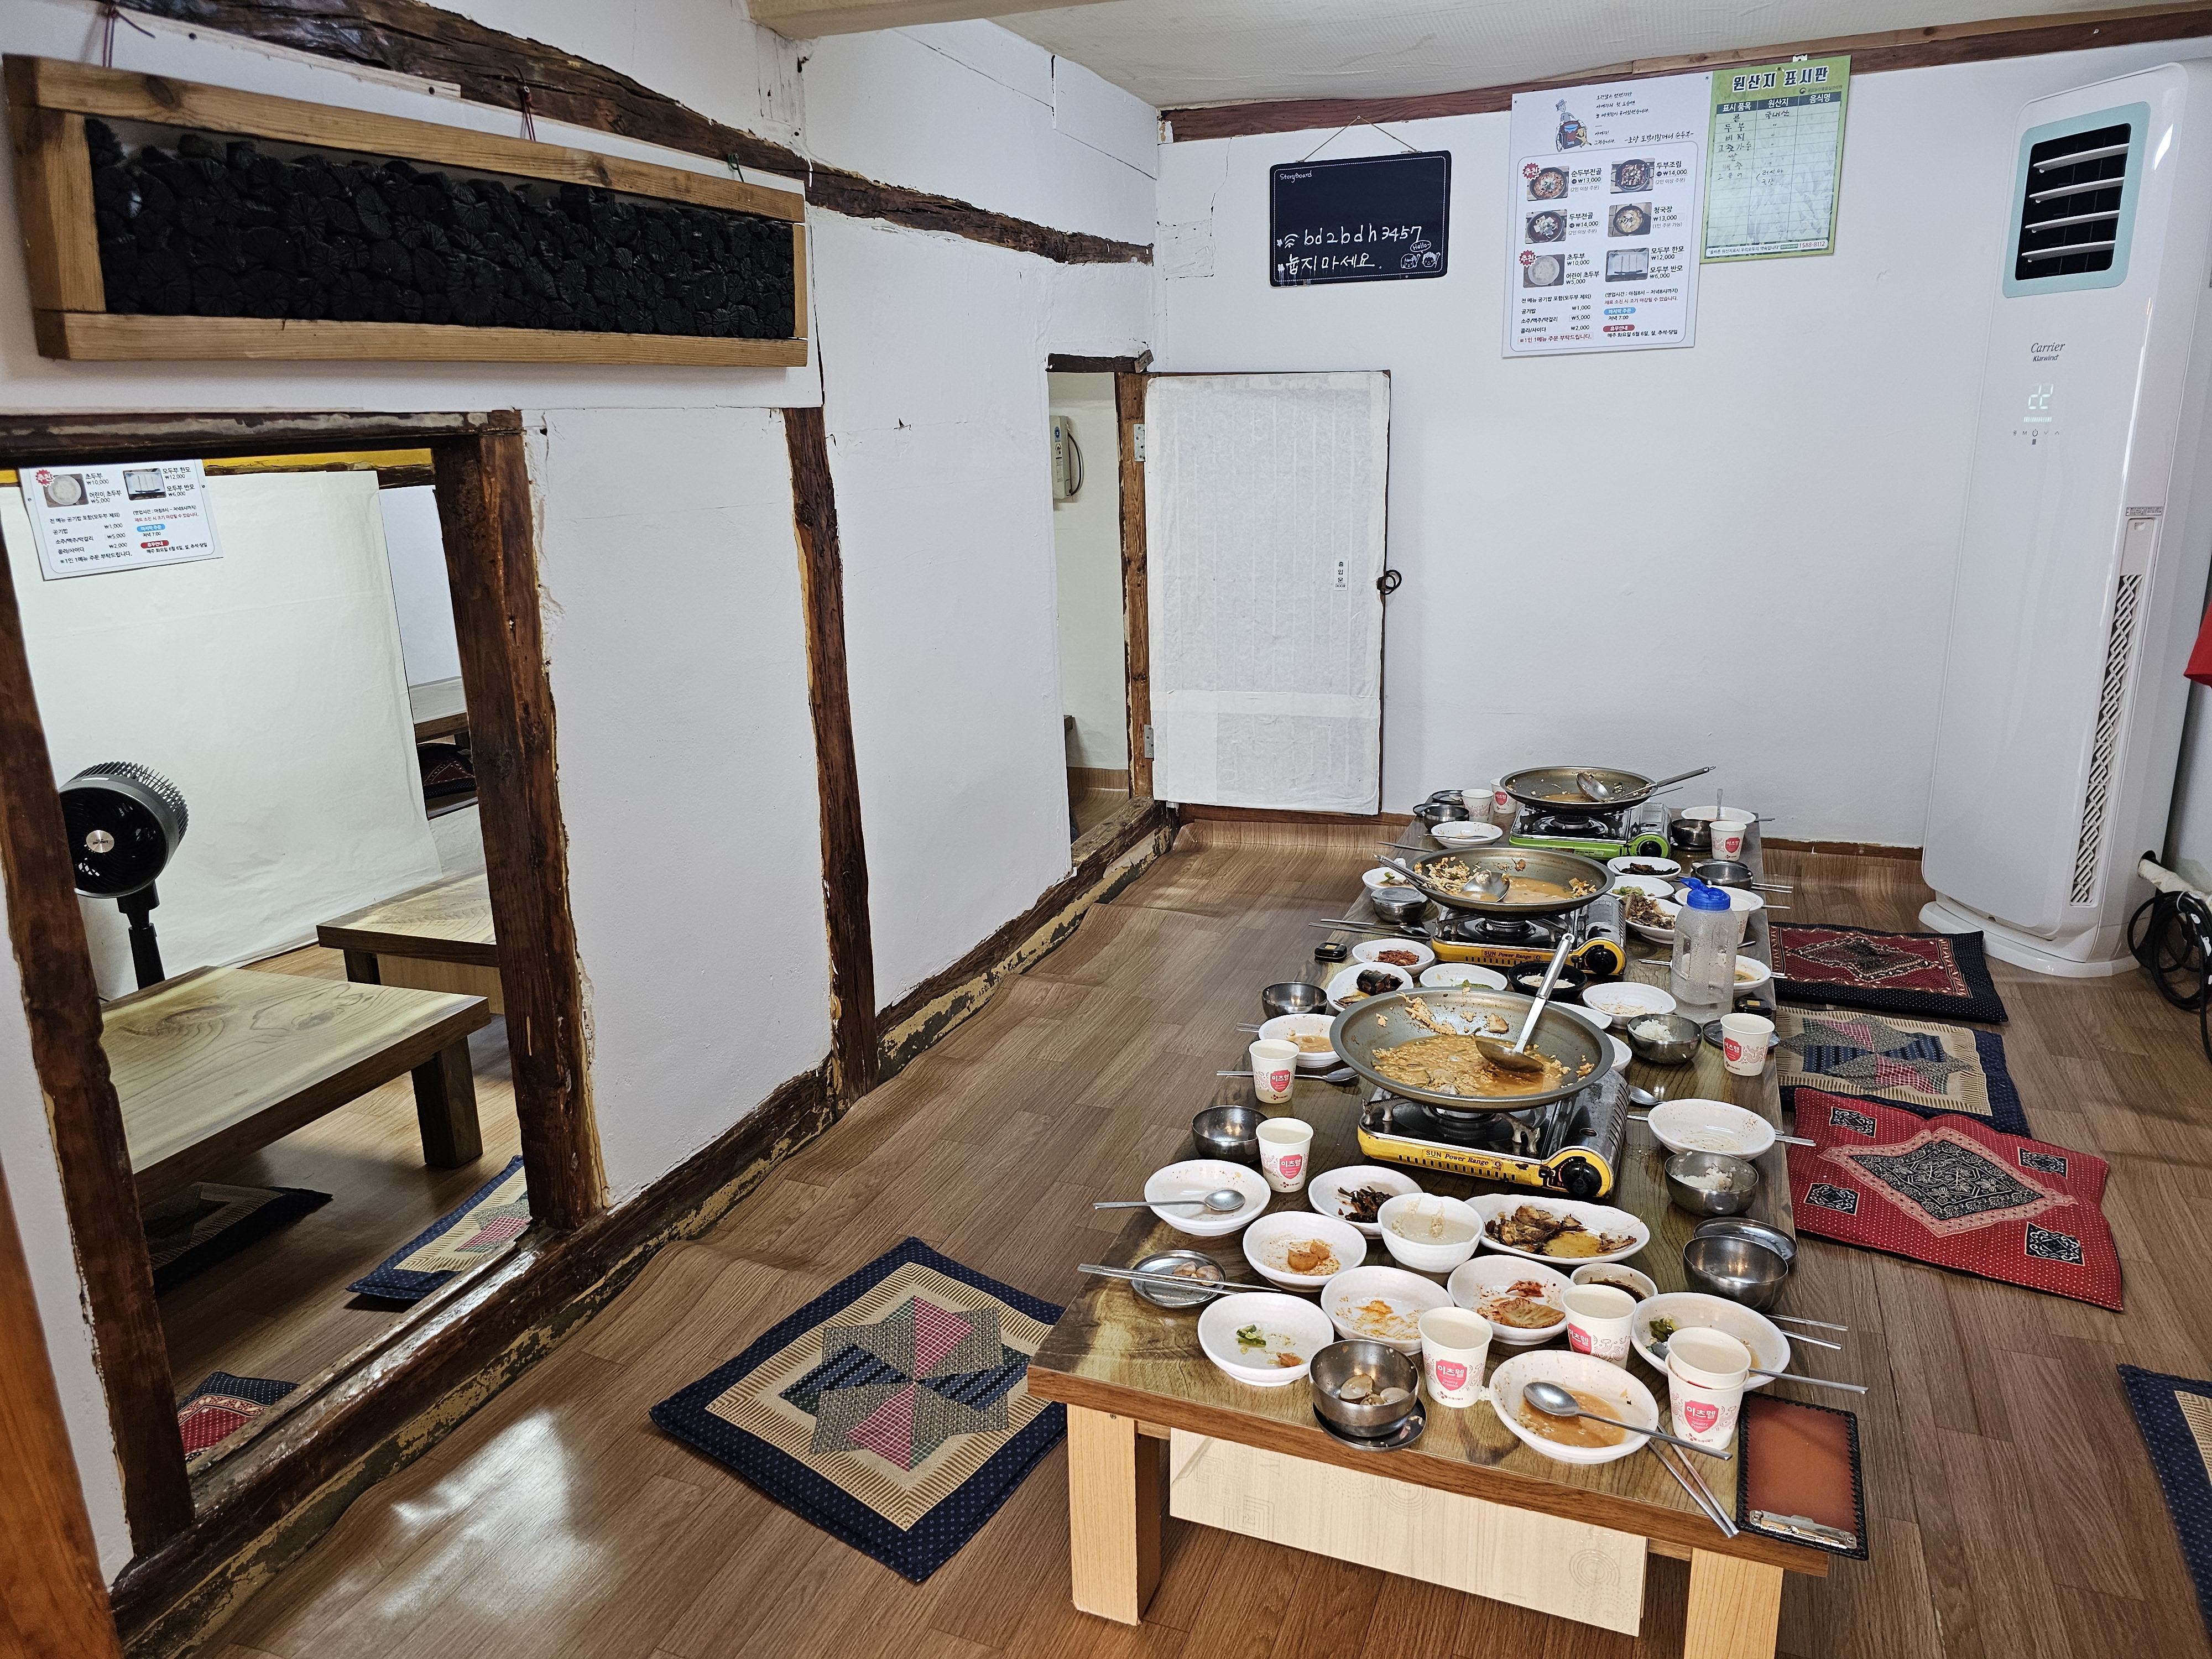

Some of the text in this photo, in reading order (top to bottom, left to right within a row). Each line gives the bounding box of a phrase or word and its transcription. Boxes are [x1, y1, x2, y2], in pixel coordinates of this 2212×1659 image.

[1734, 67, 1828, 91] 원산지 표시판
[1768, 98, 1788, 108] 원산지
[1809, 93, 1830, 103] 음식명
[1738, 102, 1752, 111] 품목
[1280, 170, 1312, 183] StoryBoard
[1525, 167, 1538, 175] 추천
[1572, 168, 1602, 177] 순두부전골
[1569, 212, 1593, 221] 두부전골
[2031, 342, 2065, 353] Carrier
[2028, 384, 2054, 409] 22
[1281, 1159, 1301, 1167] 이츠웰
[1445, 1154, 1465, 1162] Power
[1468, 1157, 1489, 1166] Range
[1569, 1329, 1588, 1346] 이츠웰
[1438, 1365, 1464, 1378] 이츠웰
[1687, 1406, 1716, 1419] 이츠웰
